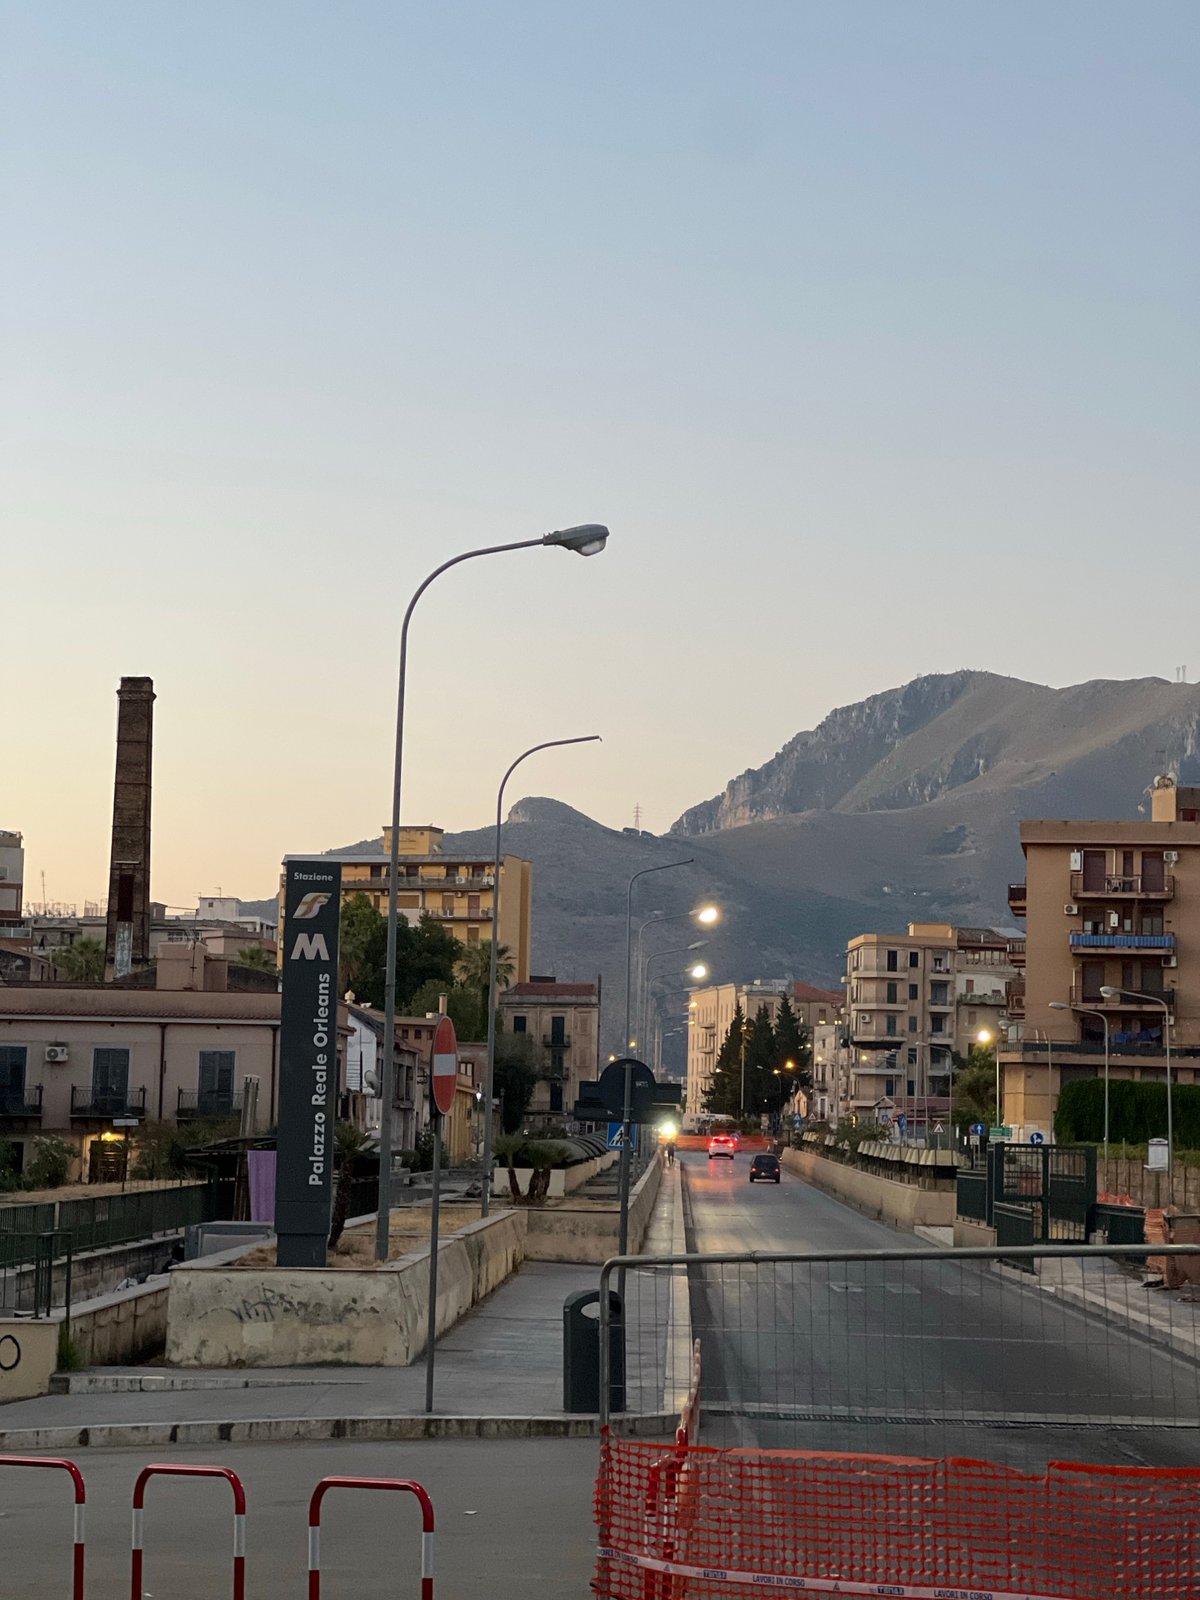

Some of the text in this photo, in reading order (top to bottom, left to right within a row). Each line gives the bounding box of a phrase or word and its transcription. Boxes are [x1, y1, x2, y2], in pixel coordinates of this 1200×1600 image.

[293, 872, 334, 882] Stazione
[308, 973, 330, 1186] Palazzo Reale Orleans
[752, 1575, 806, 1588] LAVORI IN CORSO
[933, 1589, 993, 1600] LAVORI IN CORSO
